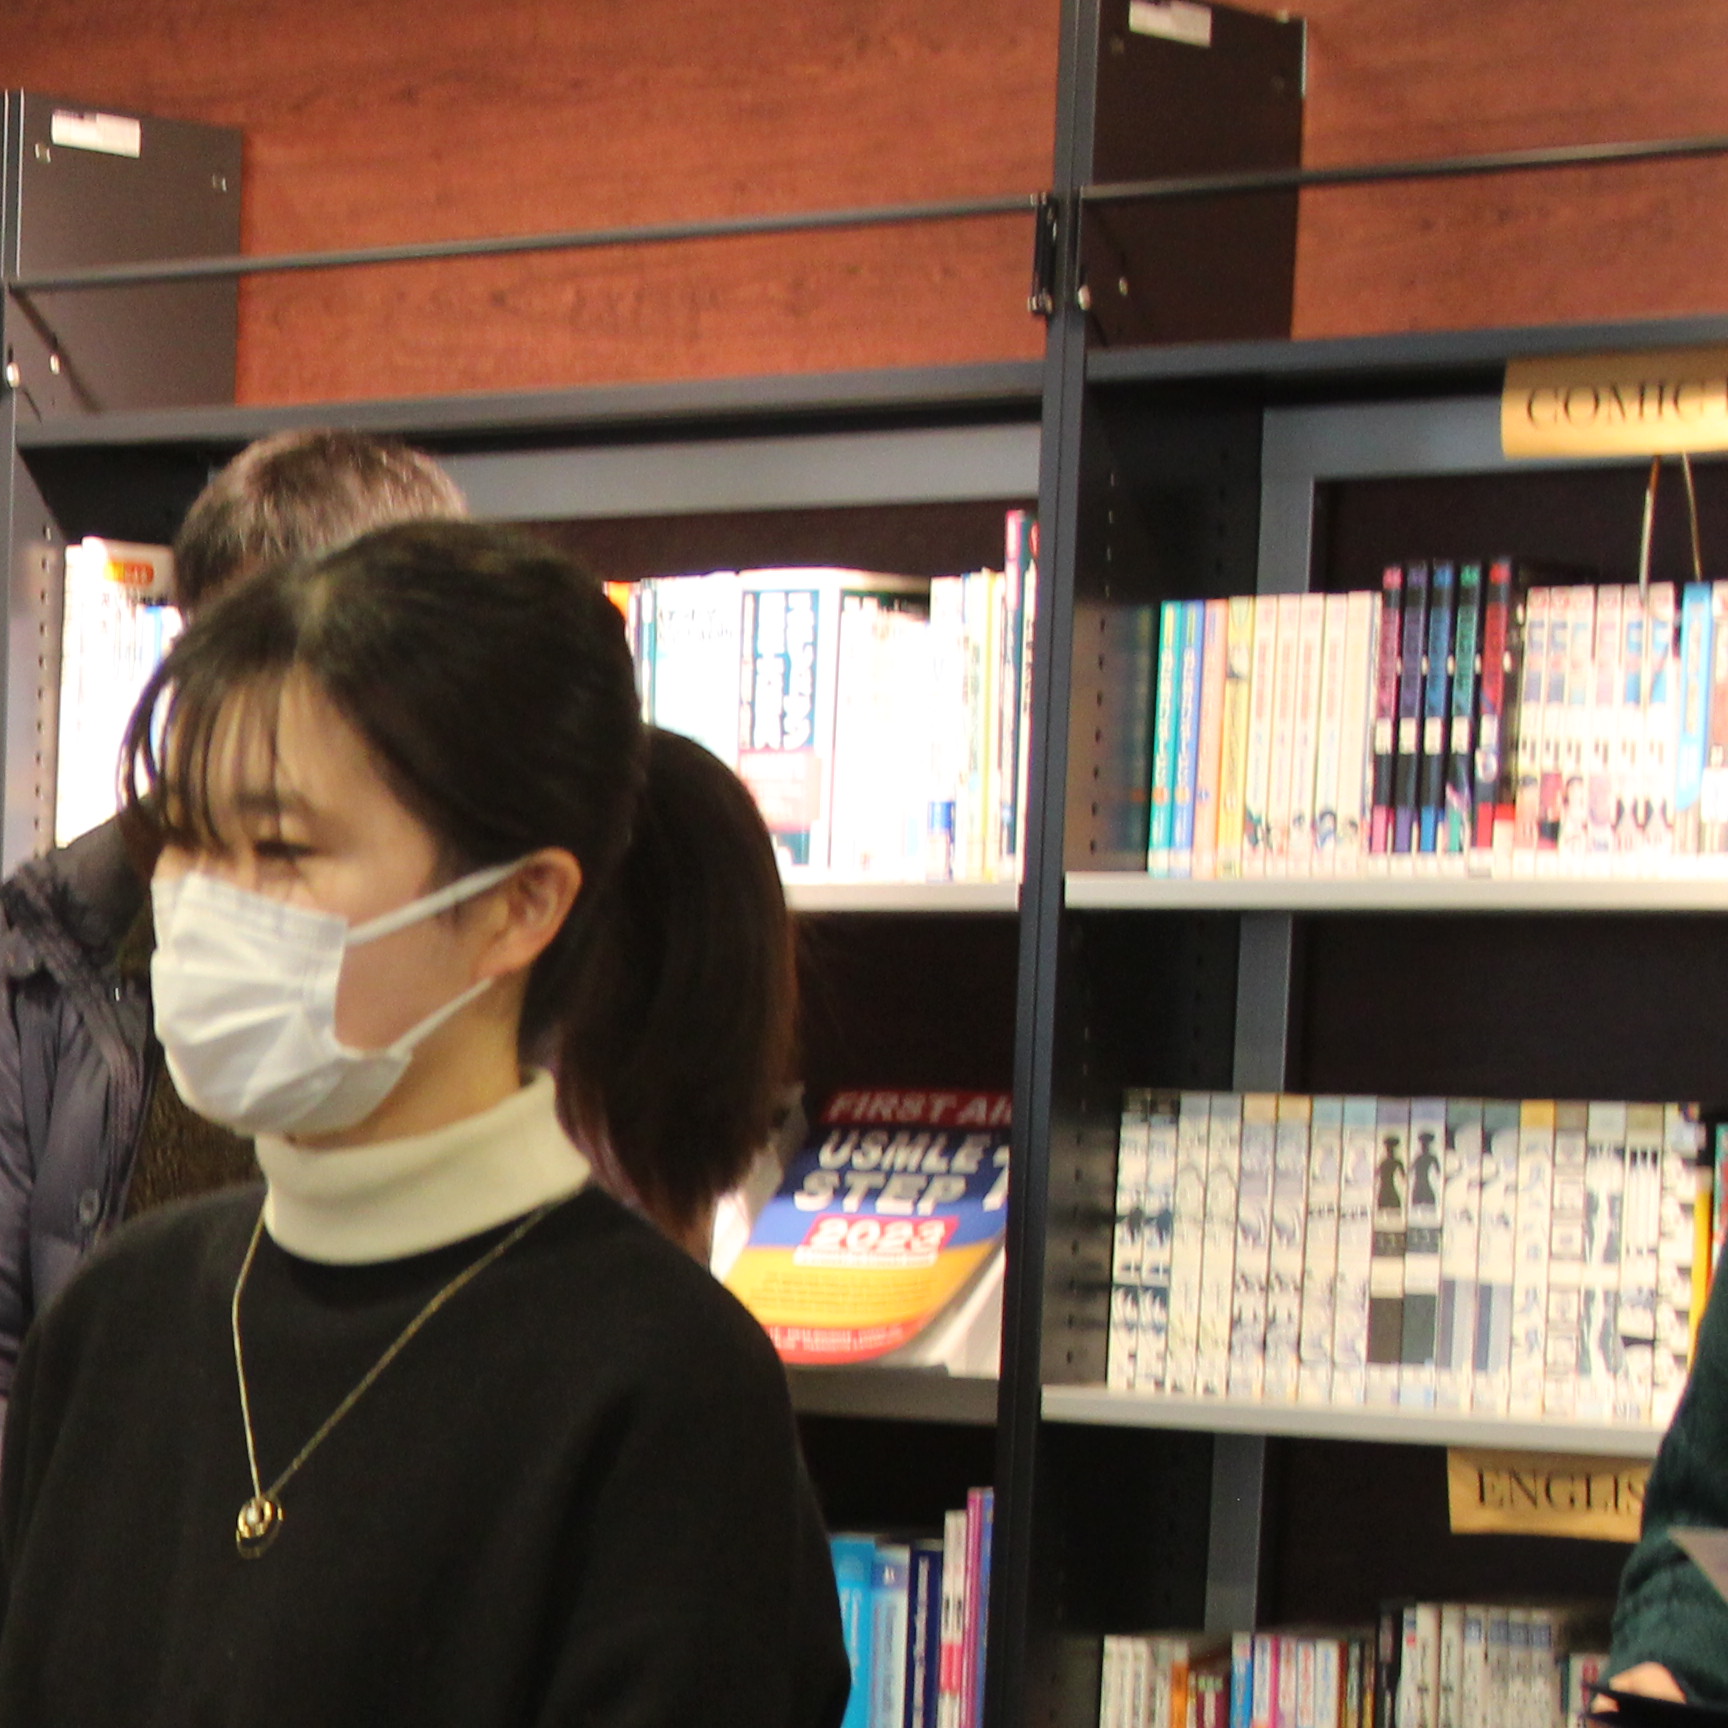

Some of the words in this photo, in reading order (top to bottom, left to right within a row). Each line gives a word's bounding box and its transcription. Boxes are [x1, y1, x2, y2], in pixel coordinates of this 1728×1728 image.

[1526, 379, 1707, 428] COMIC
[827, 1090, 957, 1125] FIRST
[818, 1129, 993, 1175] USMLE
[793, 1169, 968, 1216] STEP
[809, 1216, 947, 1253] 2023
